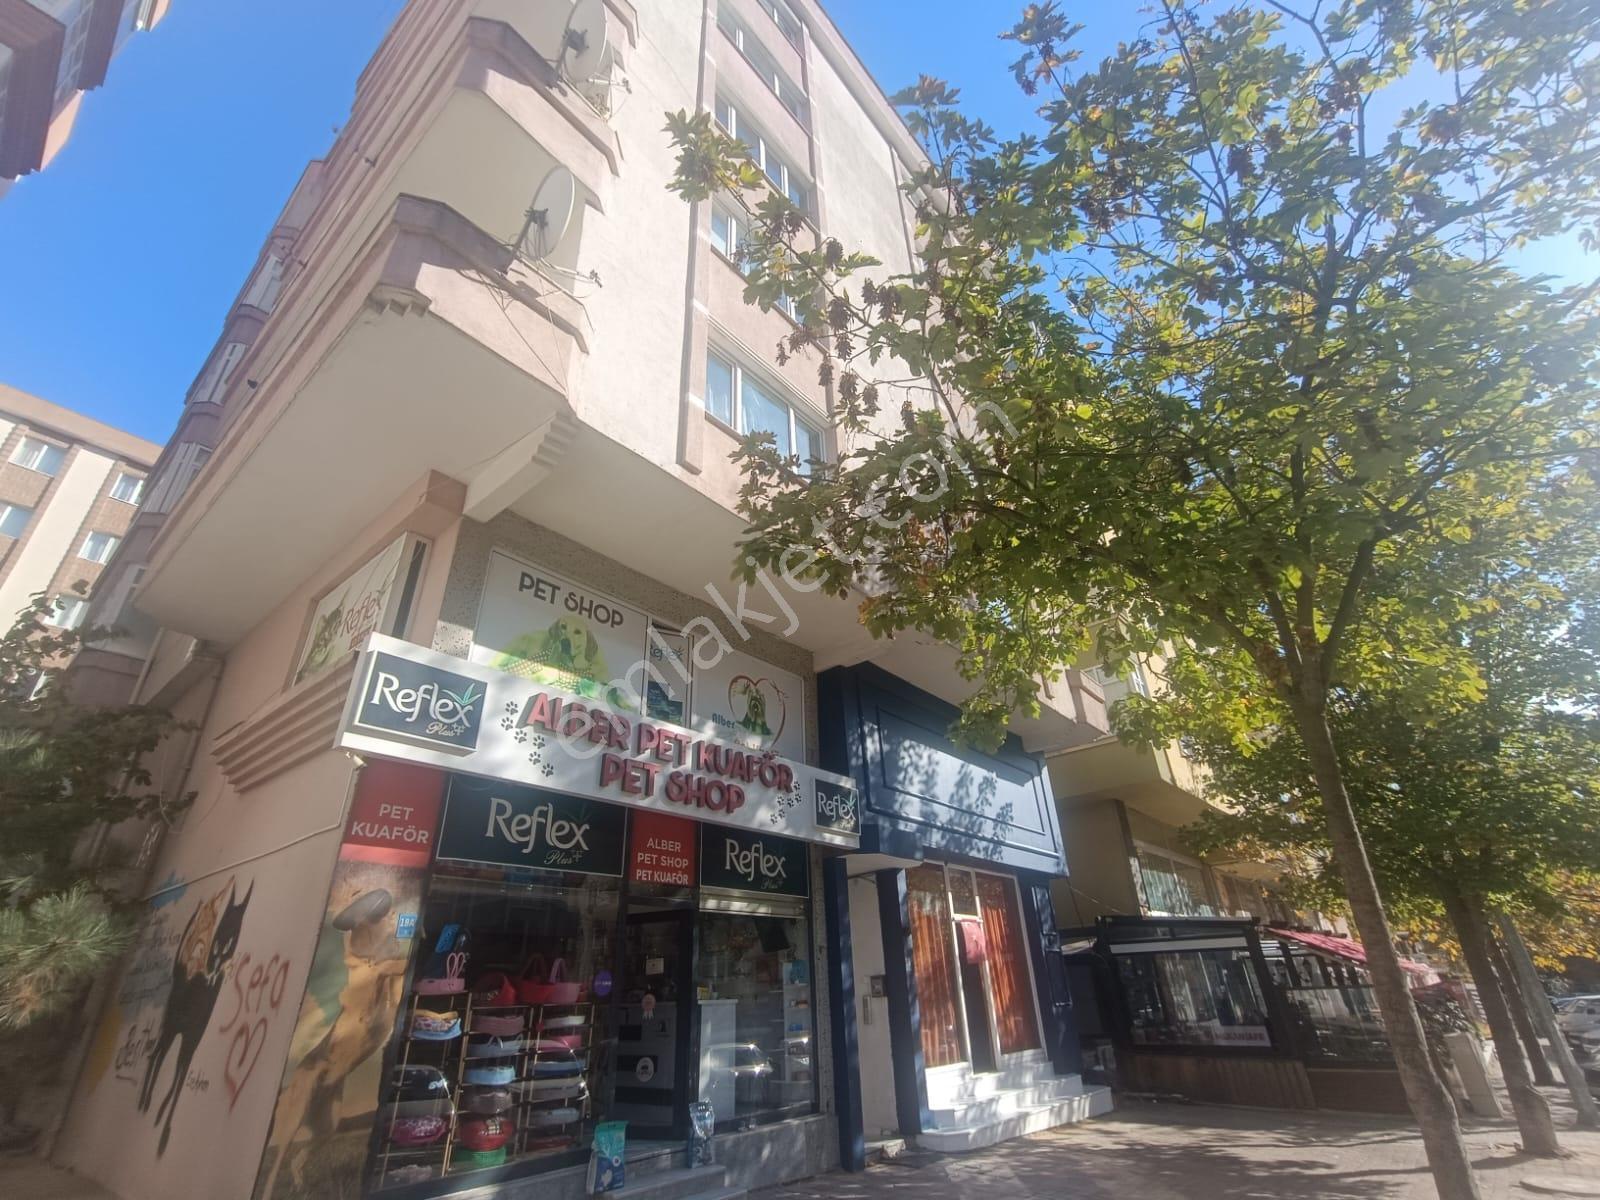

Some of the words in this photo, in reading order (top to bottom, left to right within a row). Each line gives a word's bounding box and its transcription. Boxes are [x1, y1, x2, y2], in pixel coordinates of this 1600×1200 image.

[518, 571, 560, 604] PET
[564, 591, 624, 628] SHOP
[370, 671, 474, 727] Reflex
[518, 692, 632, 751] ALBER
[637, 722, 693, 768] PET
[698, 740, 794, 793] KUAFÖR
[600, 753, 662, 798] PET
[666, 770, 745, 814] SHOP
[379, 803, 414, 822] PET
[817, 791, 857, 822] Reflex
[351, 821, 429, 844] KUAFÖR
[485, 797, 591, 854] Reflex
[637, 852, 658, 865] PET
[660, 855, 689, 869] SHOP
[646, 837, 682, 853] ALBER
[724, 838, 788, 882] Reflex
[636, 870, 653, 882] PET
[653, 870, 689, 886] KUAFÖR
